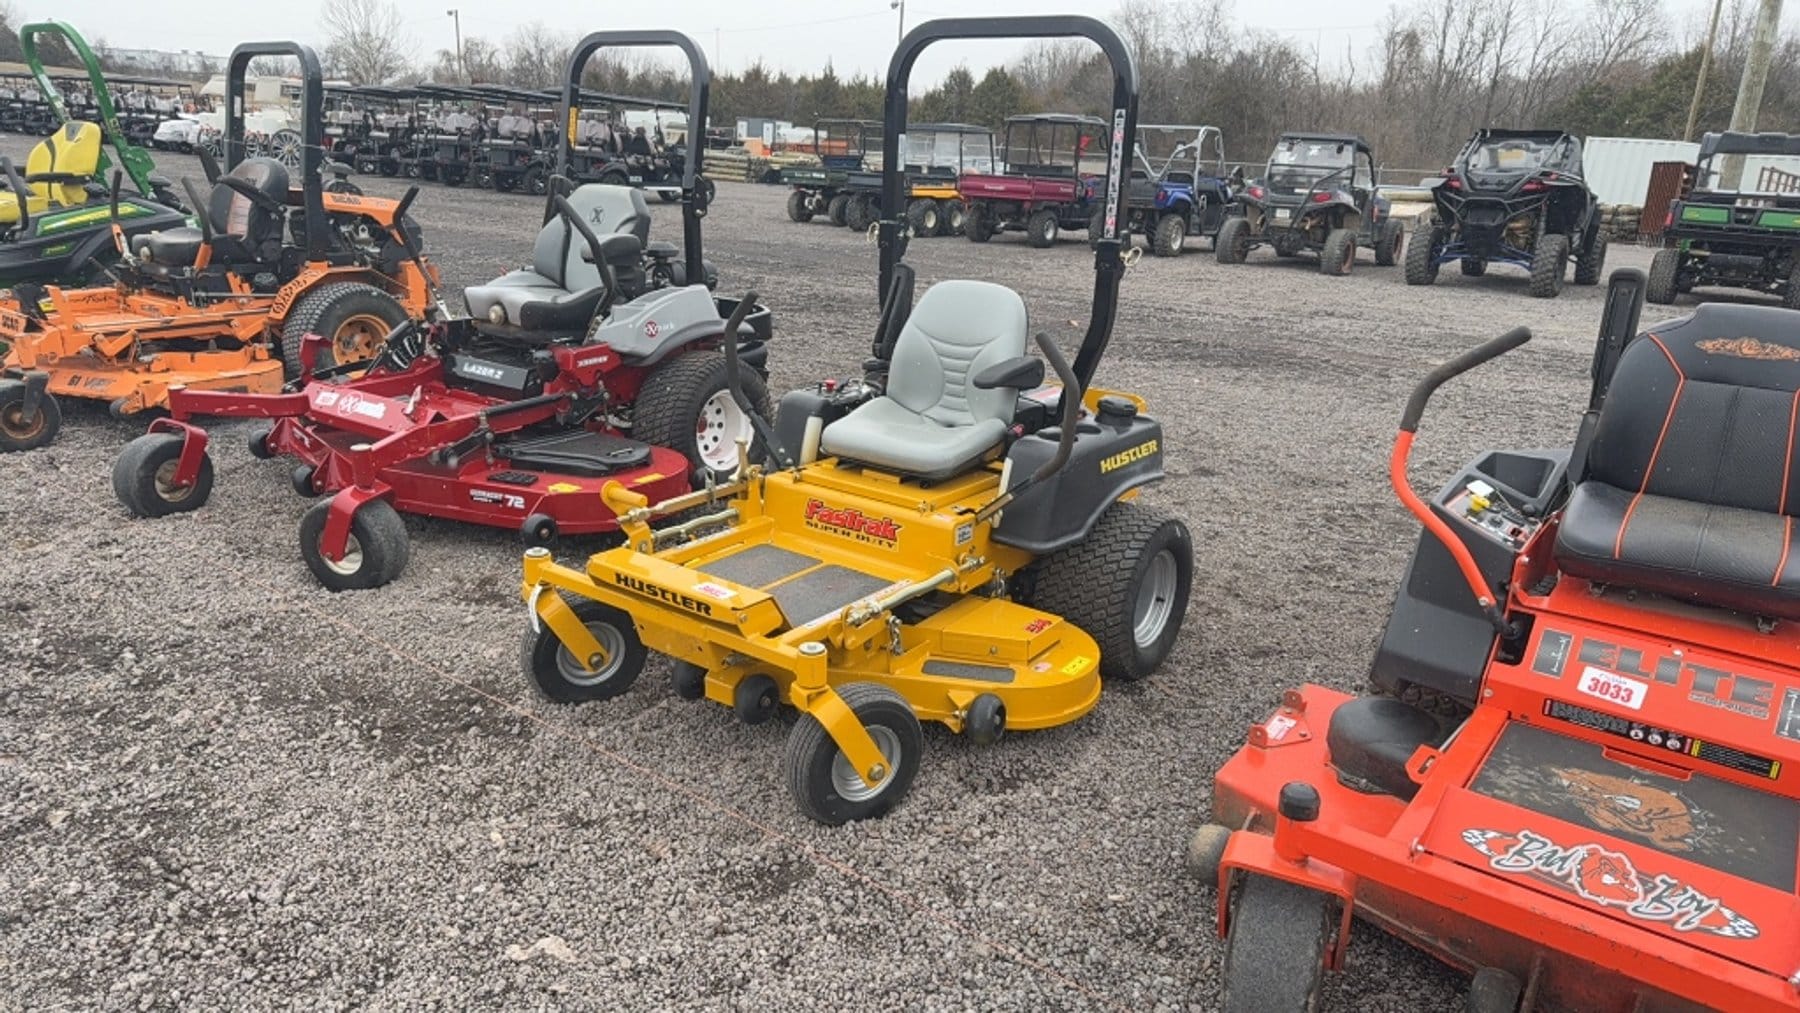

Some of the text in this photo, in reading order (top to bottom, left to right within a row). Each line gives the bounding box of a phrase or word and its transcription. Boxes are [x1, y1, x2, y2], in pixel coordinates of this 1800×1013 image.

[1100, 439, 1158, 474] HUSTLER
[504, 494, 526, 509] 72
[806, 520, 895, 549] SUPER DUTY
[614, 572, 712, 617] HUSTLER
[1587, 676, 1634, 703] 3033
[1492, 830, 1720, 931] Bad Boy
